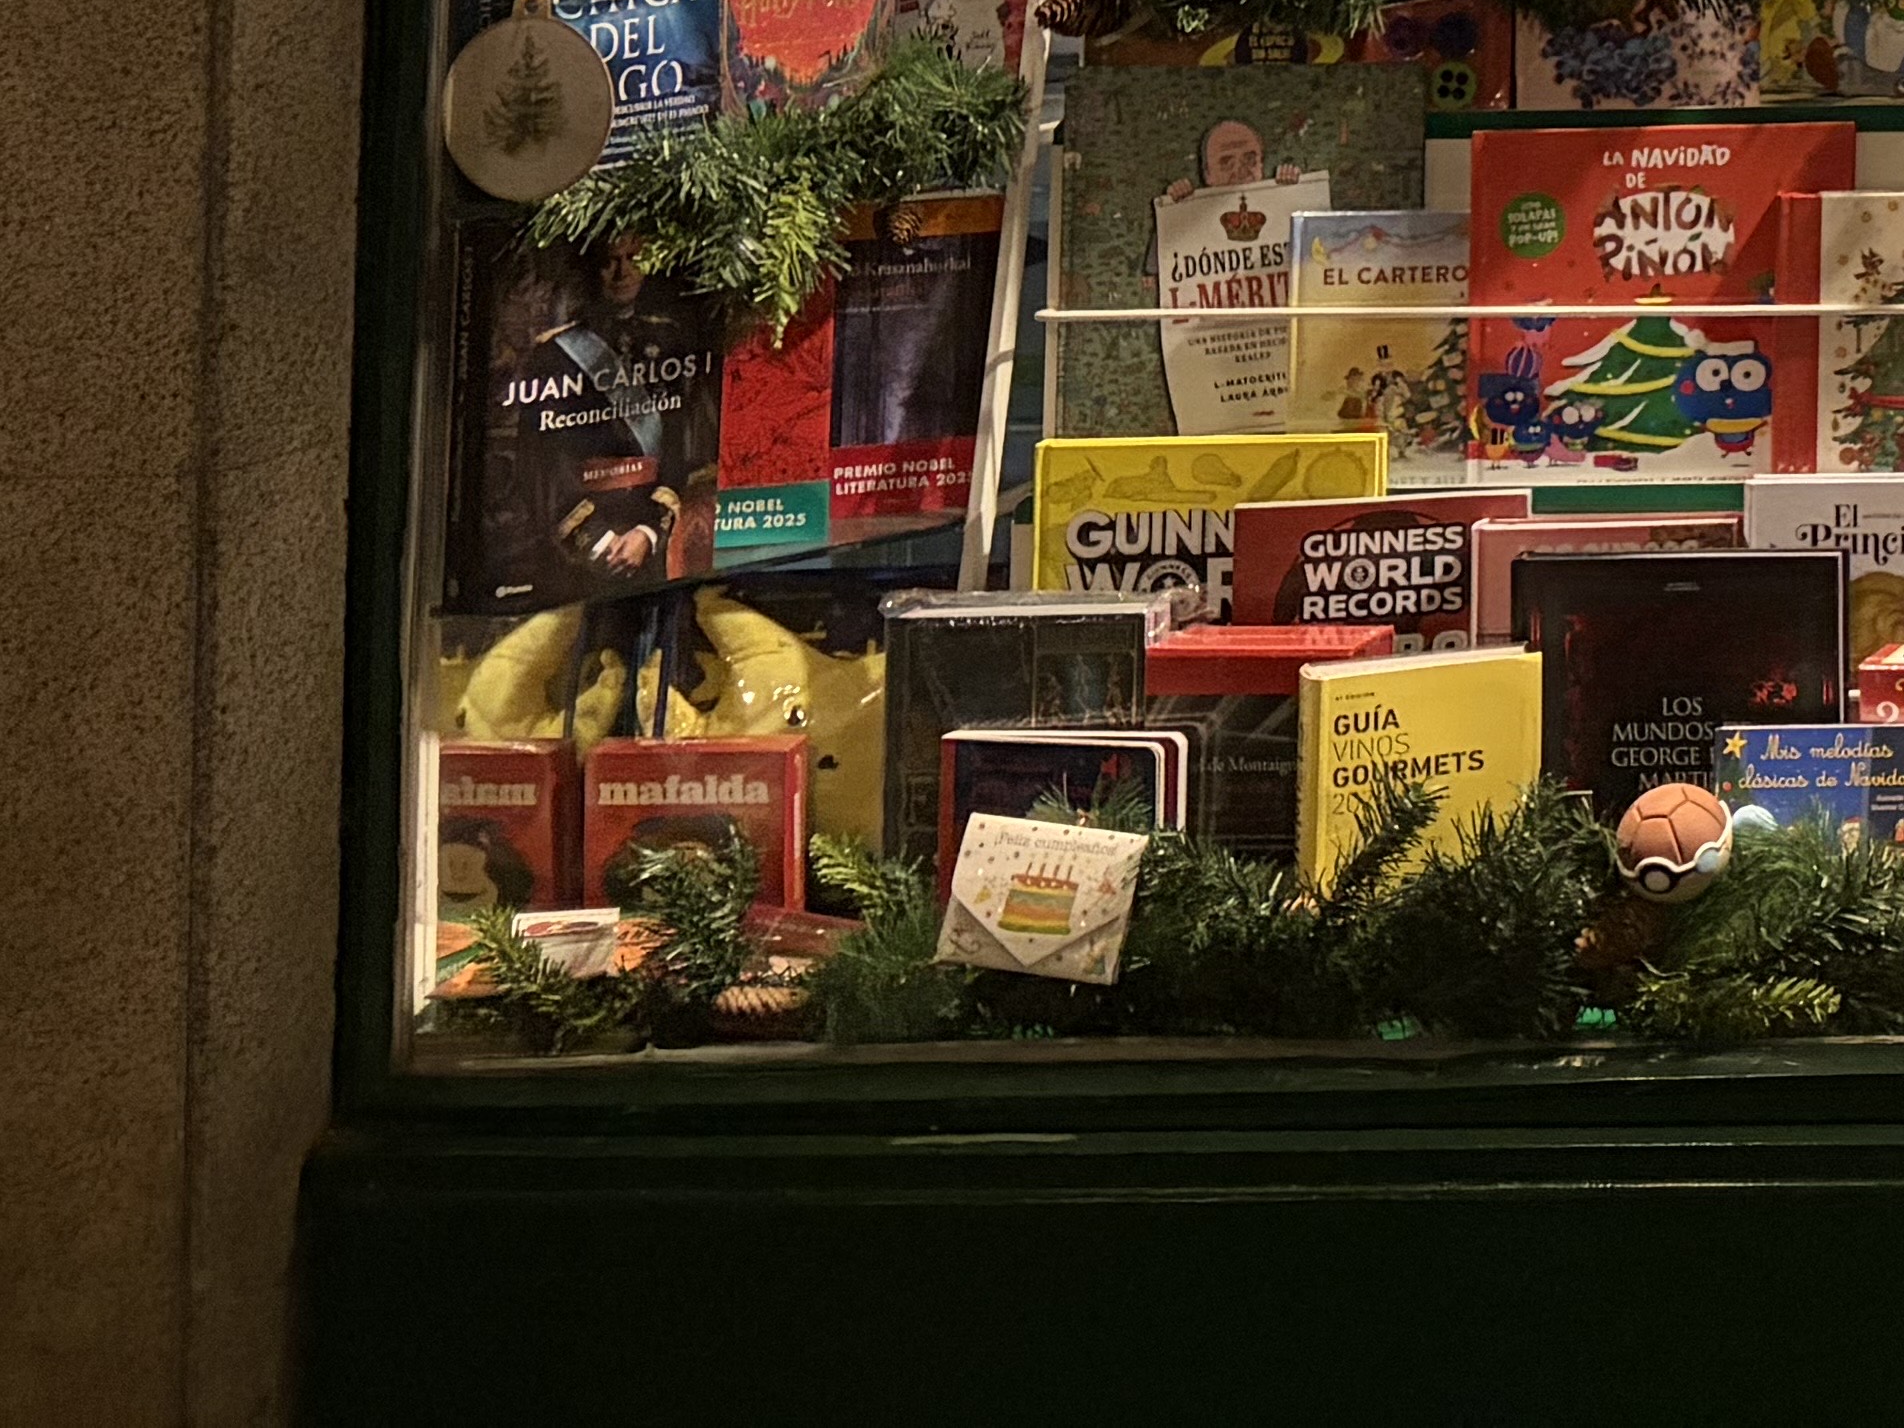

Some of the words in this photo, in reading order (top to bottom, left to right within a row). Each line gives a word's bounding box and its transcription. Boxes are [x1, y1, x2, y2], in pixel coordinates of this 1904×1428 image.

[589, 15, 665, 62] DEL
[1603, 151, 1624, 166] LA
[1631, 145, 1730, 168] NAVIDAD
[1626, 173, 1645, 188] DE
[1324, 268, 1348, 286] EL
[1358, 265, 1469, 285] CARTERO
[503, 373, 584, 407] JUAN
[593, 354, 697, 392] CARLOS
[705, 353, 711, 374] I
[538, 393, 682, 433] Reconciliación
[834, 463, 896, 479] PREMIO
[903, 458, 954, 473] NOBEL
[836, 477, 929, 495] LITERATURA
[1833, 504, 1859, 528] El
[1303, 525, 1464, 558] GUINNESS
[1303, 555, 1462, 592] WORLD
[1303, 586, 1462, 620] RECORDS
[1334, 705, 1400, 735] GUÍA
[1334, 733, 1410, 761] VINOS
[1761, 734, 1802, 760] Mis
[1810, 734, 1895, 759] melodías
[1333, 749, 1485, 788] GOURMETS
[1738, 765, 1808, 789] clásicas
[1816, 766, 1838, 787] de
[597, 774, 770, 806] mafalda
